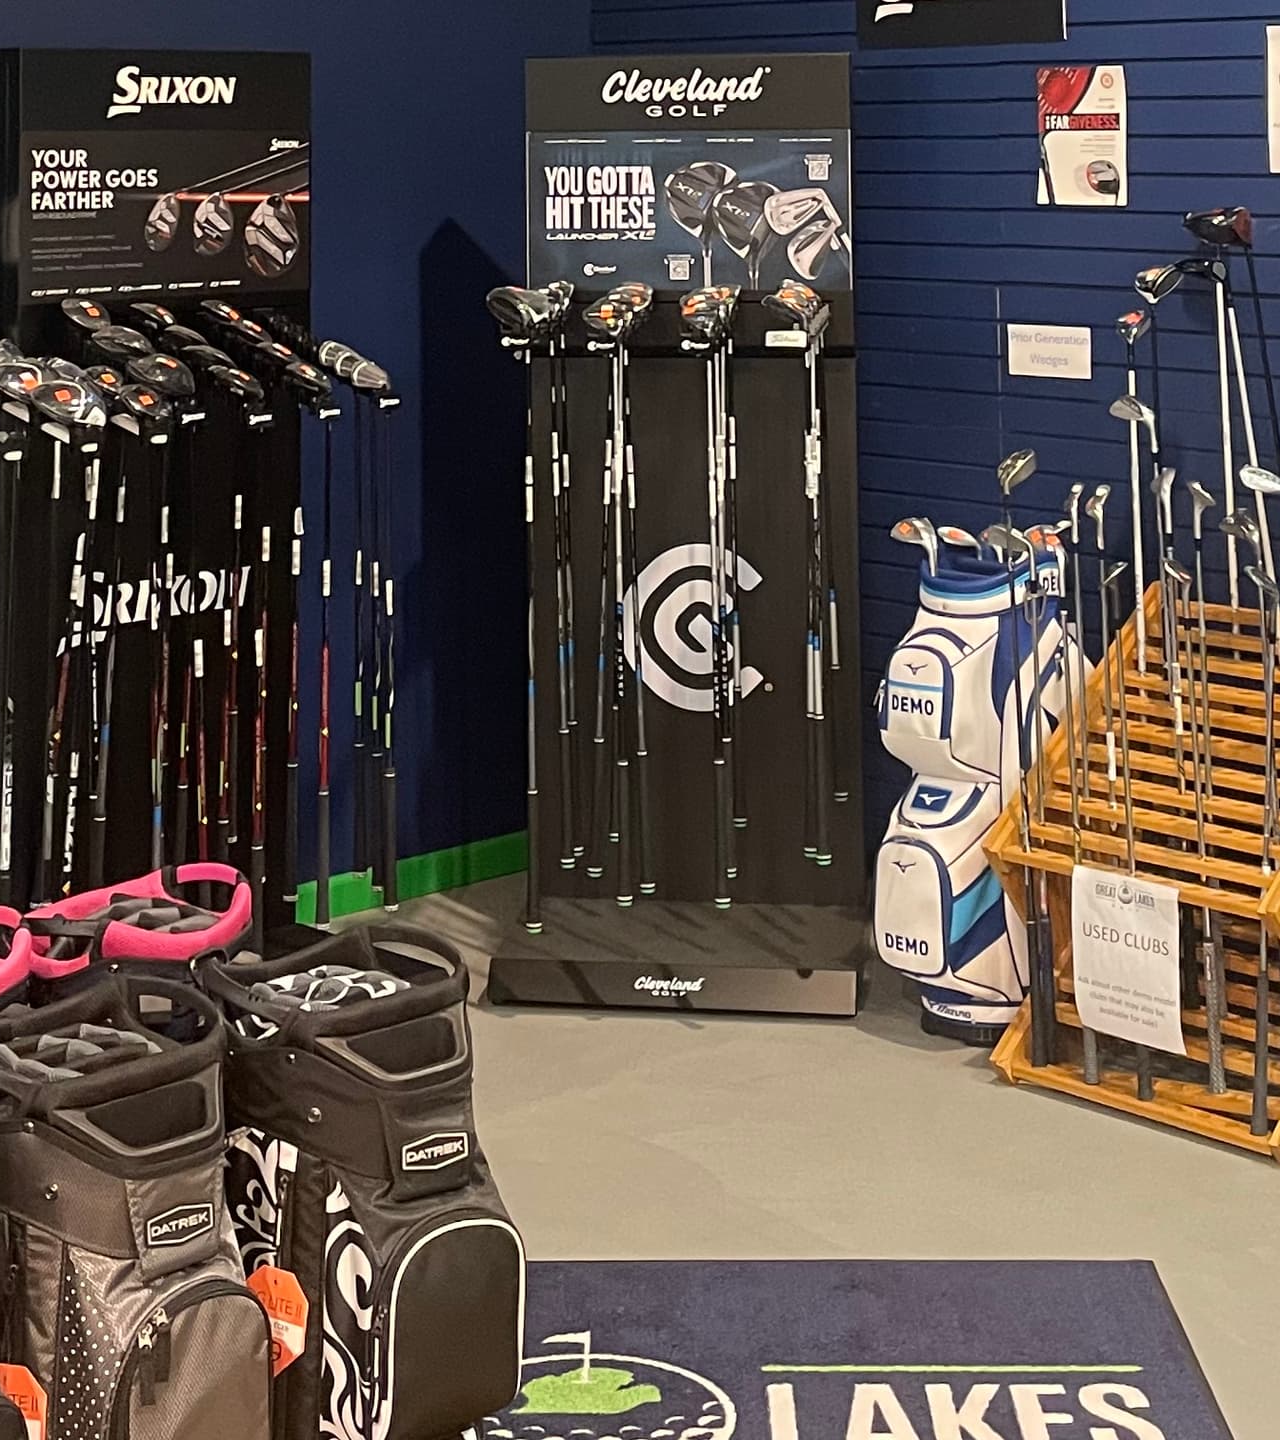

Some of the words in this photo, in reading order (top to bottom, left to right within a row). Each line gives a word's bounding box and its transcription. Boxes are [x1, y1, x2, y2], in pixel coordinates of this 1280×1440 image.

[107, 66, 237, 118] SRIXON
[602, 67, 765, 104] Cleveland
[645, 103, 728, 118] GOLF
[31, 149, 88, 168] YOUR
[31, 171, 101, 189] POWER
[105, 168, 158, 188] GOES
[544, 166, 583, 196] YOU
[587, 165, 655, 196] GOTTA
[31, 190, 114, 211] FARTHER
[545, 197, 584, 230] HIT
[587, 198, 656, 229] THESE
[545, 232, 619, 241] LAUNCHER
[891, 693, 935, 717] DEMO
[885, 934, 929, 957] DEMO
[1082, 922, 1120, 943] USED
[1124, 932, 1169, 956] CLUBS
[634, 975, 706, 991] Cleveland
[406, 1140, 463, 1163] DATREK
[151, 1211, 208, 1237] DATREK
